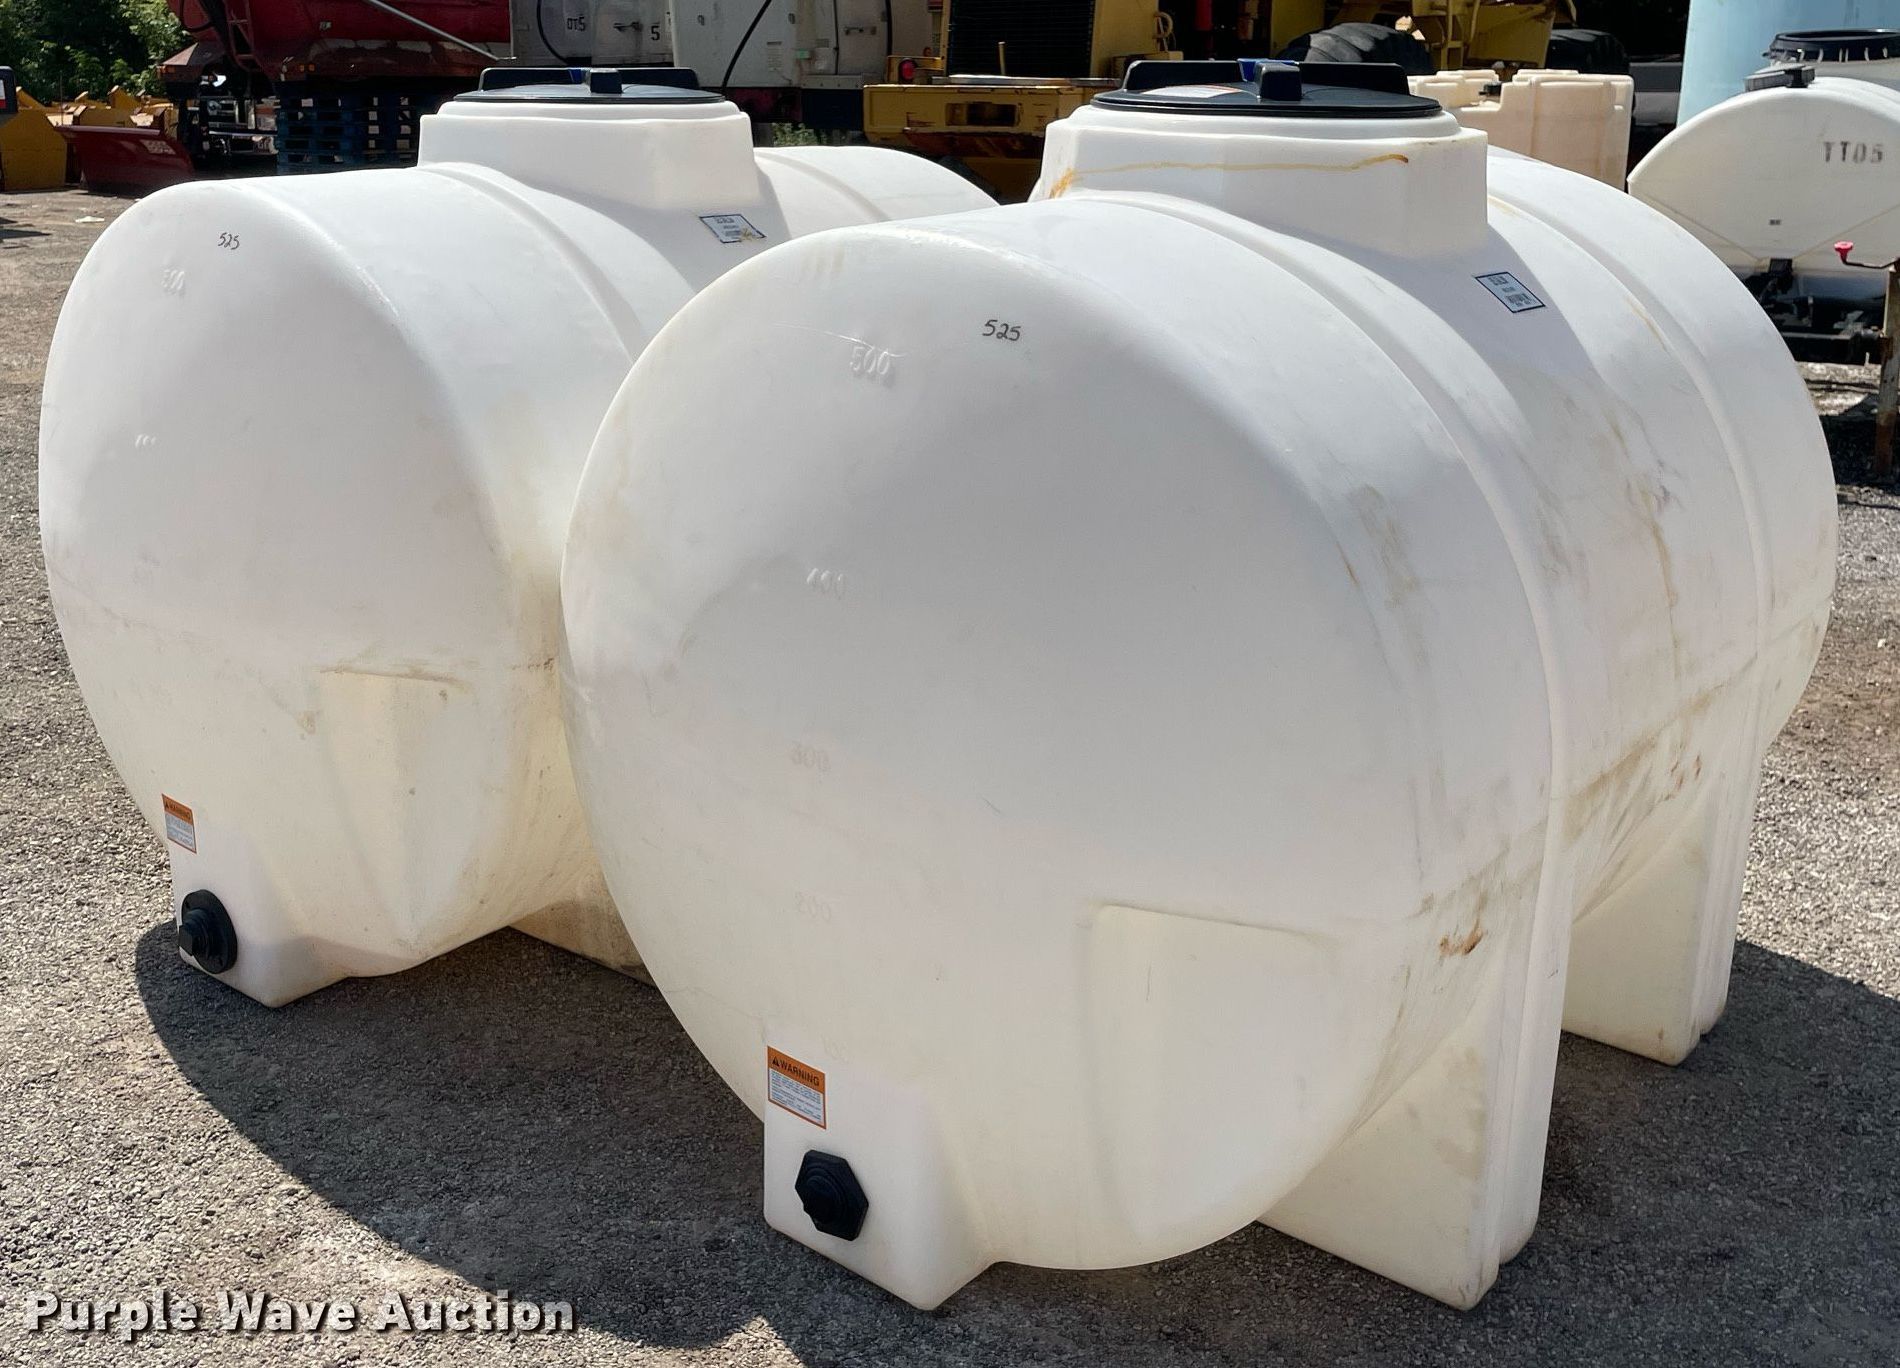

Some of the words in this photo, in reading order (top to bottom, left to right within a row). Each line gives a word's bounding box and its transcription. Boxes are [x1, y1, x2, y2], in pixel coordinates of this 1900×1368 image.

[217, 232, 240, 250] 525
[981, 319, 1021, 342] 525
[780, 1059, 820, 1086] WARNING
